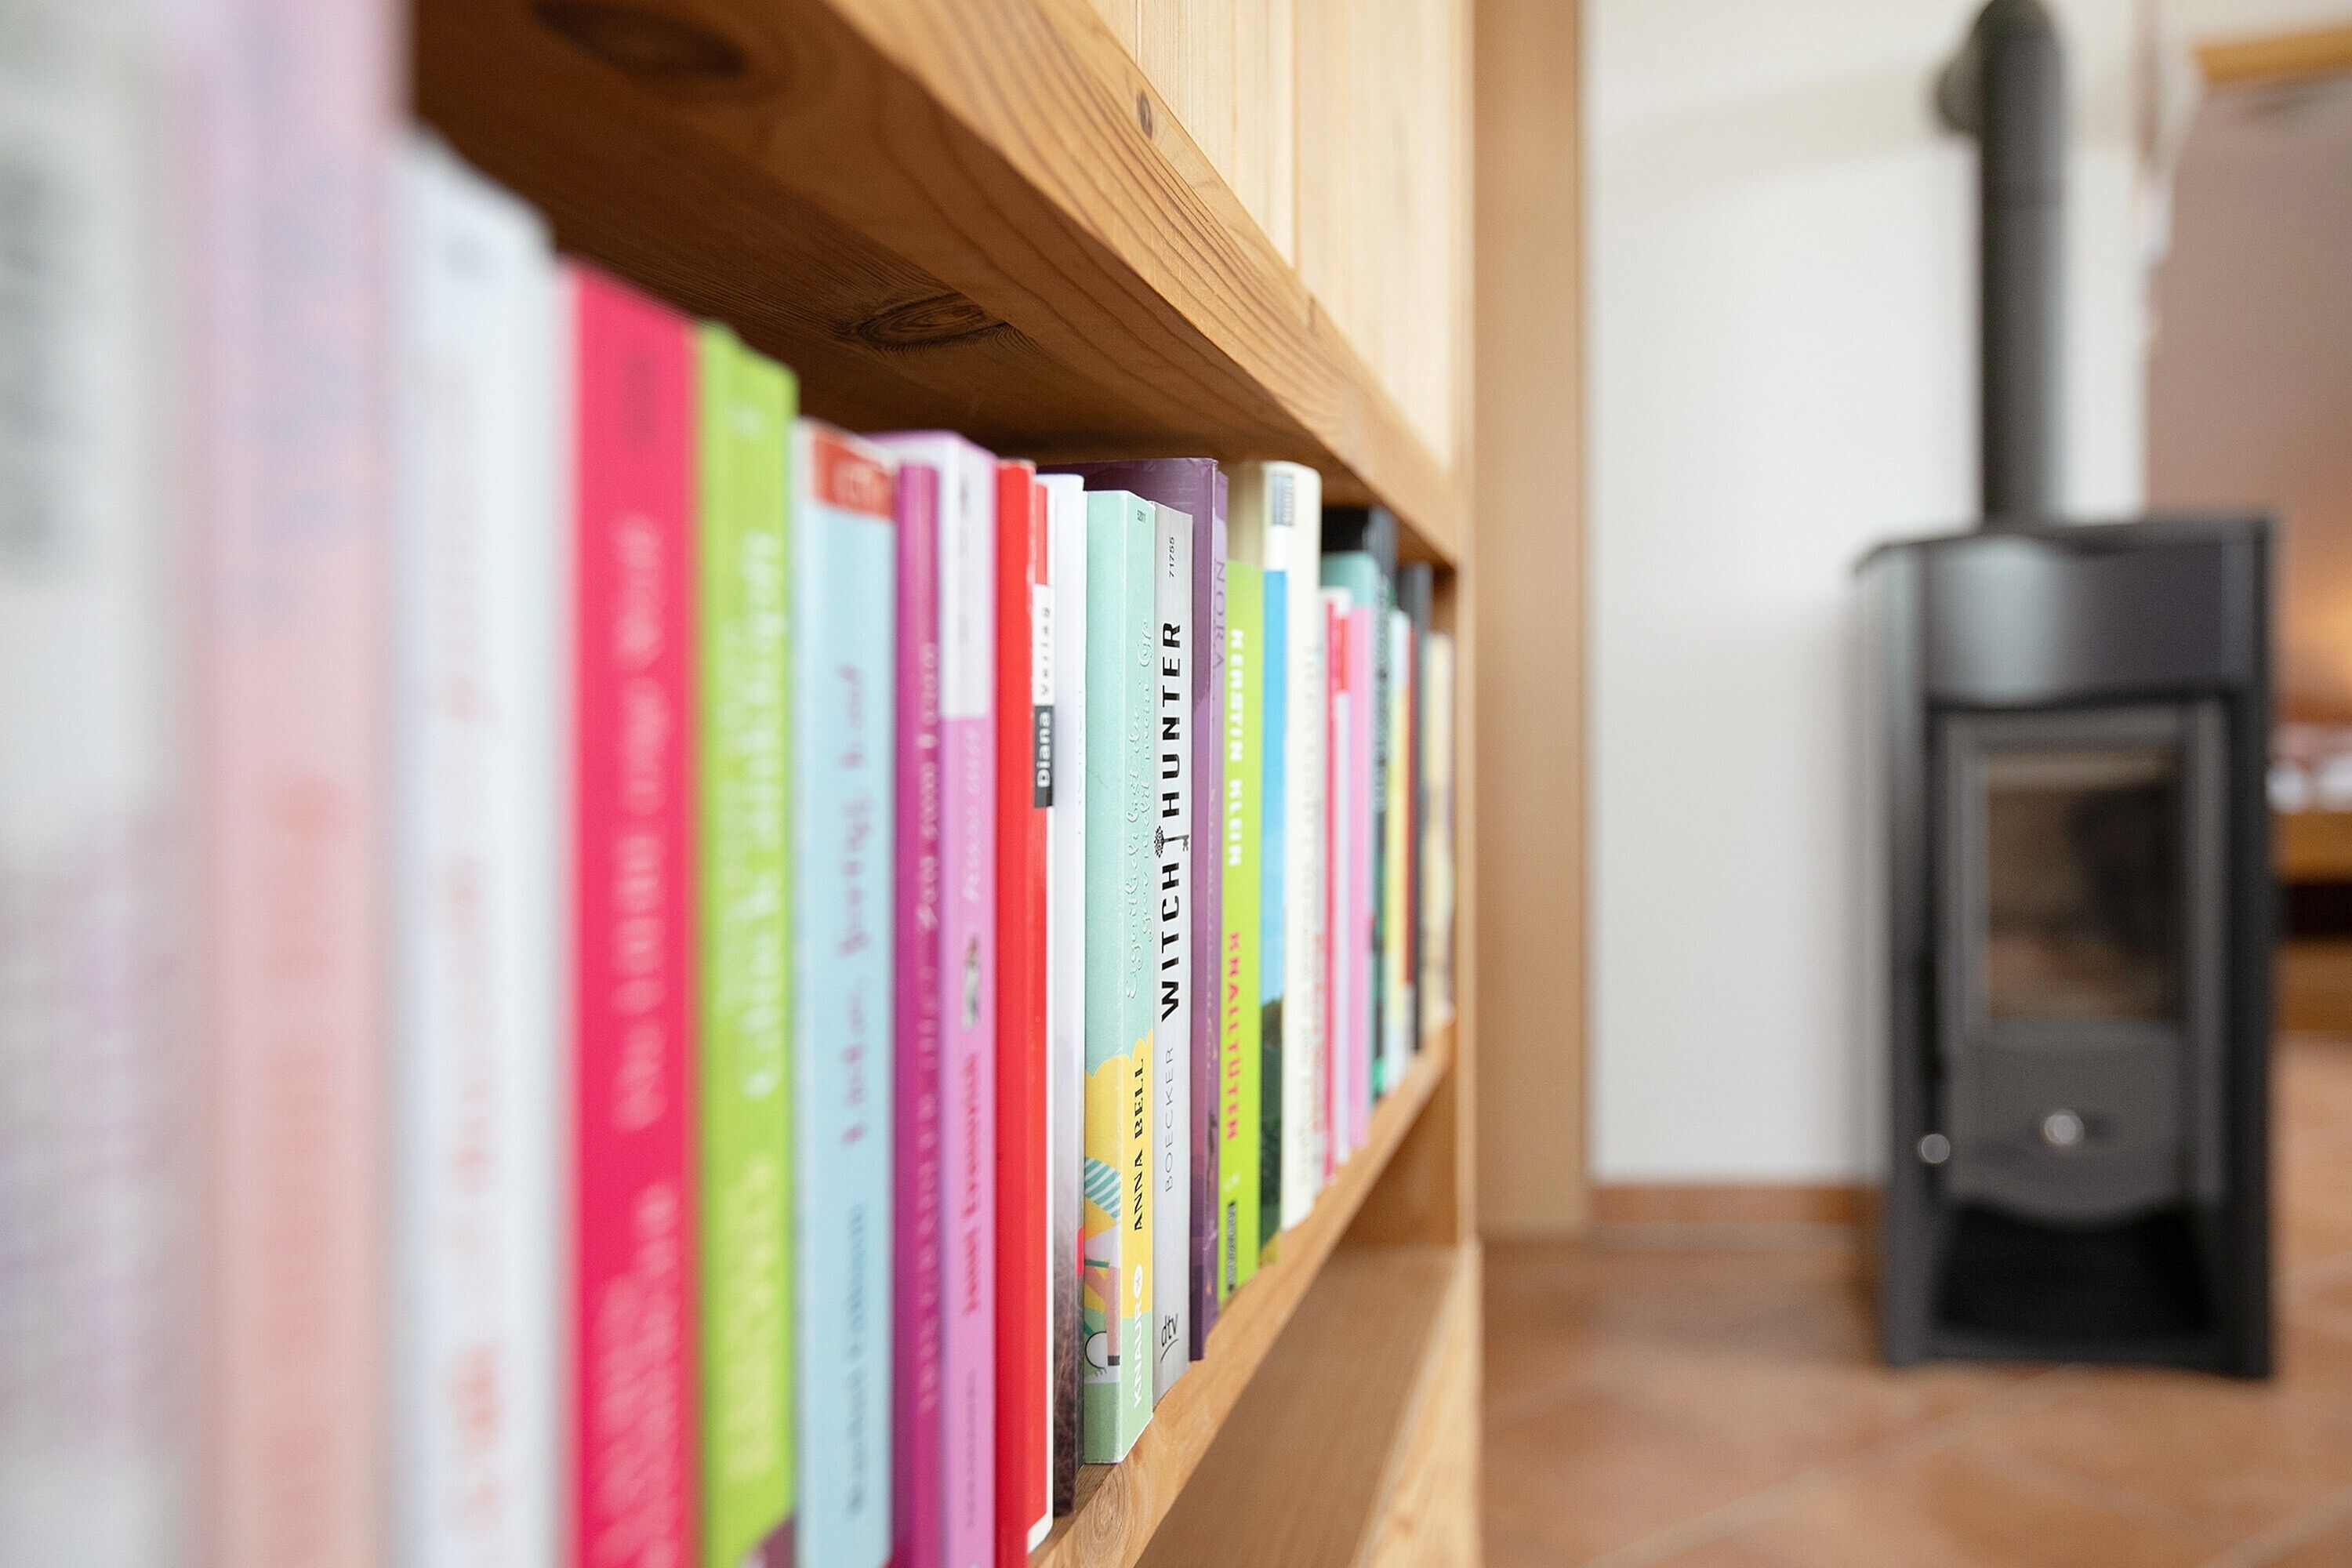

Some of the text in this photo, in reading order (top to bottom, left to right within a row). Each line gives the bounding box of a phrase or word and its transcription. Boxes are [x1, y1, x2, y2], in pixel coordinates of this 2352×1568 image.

[1036, 607, 1051, 788] Diana Verlag
[1126, 771, 1139, 823] bist
[1161, 622, 1180, 1022] WITCH HUNTER
[1229, 779, 1243, 866] KLEIN
[1134, 1058, 1143, 1231] ANNA BELL
[1164, 1047, 1174, 1192] BOECKER
[1160, 1312, 1178, 1347] dtv
